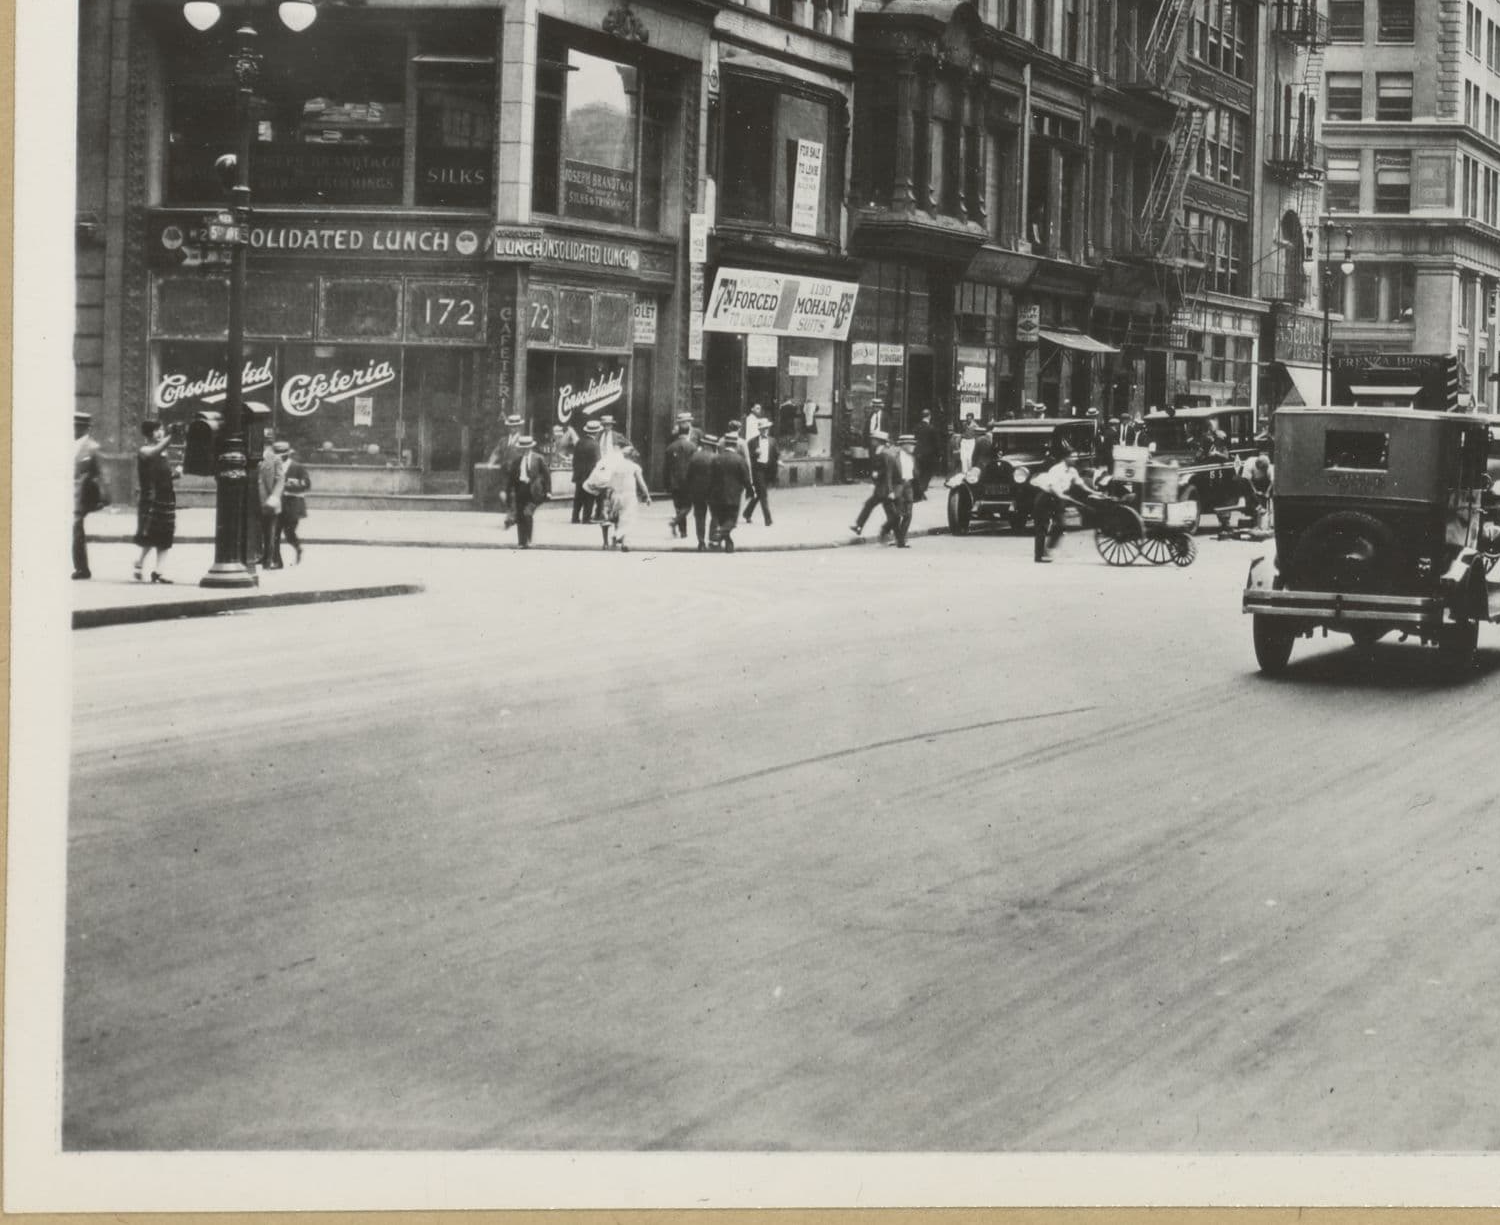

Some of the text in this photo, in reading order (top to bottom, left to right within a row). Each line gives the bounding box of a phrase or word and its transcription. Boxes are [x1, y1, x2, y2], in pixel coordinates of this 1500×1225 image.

[427, 168, 486, 185] SILKS
[373, 229, 449, 252] LUNCH
[497, 240, 543, 259] LUNCH
[425, 299, 477, 326] 172
[733, 291, 779, 313] FORCED
[794, 296, 838, 319] MOHAIR
[280, 358, 396, 417] Cafeteria
[557, 366, 625, 424] Consolidated
